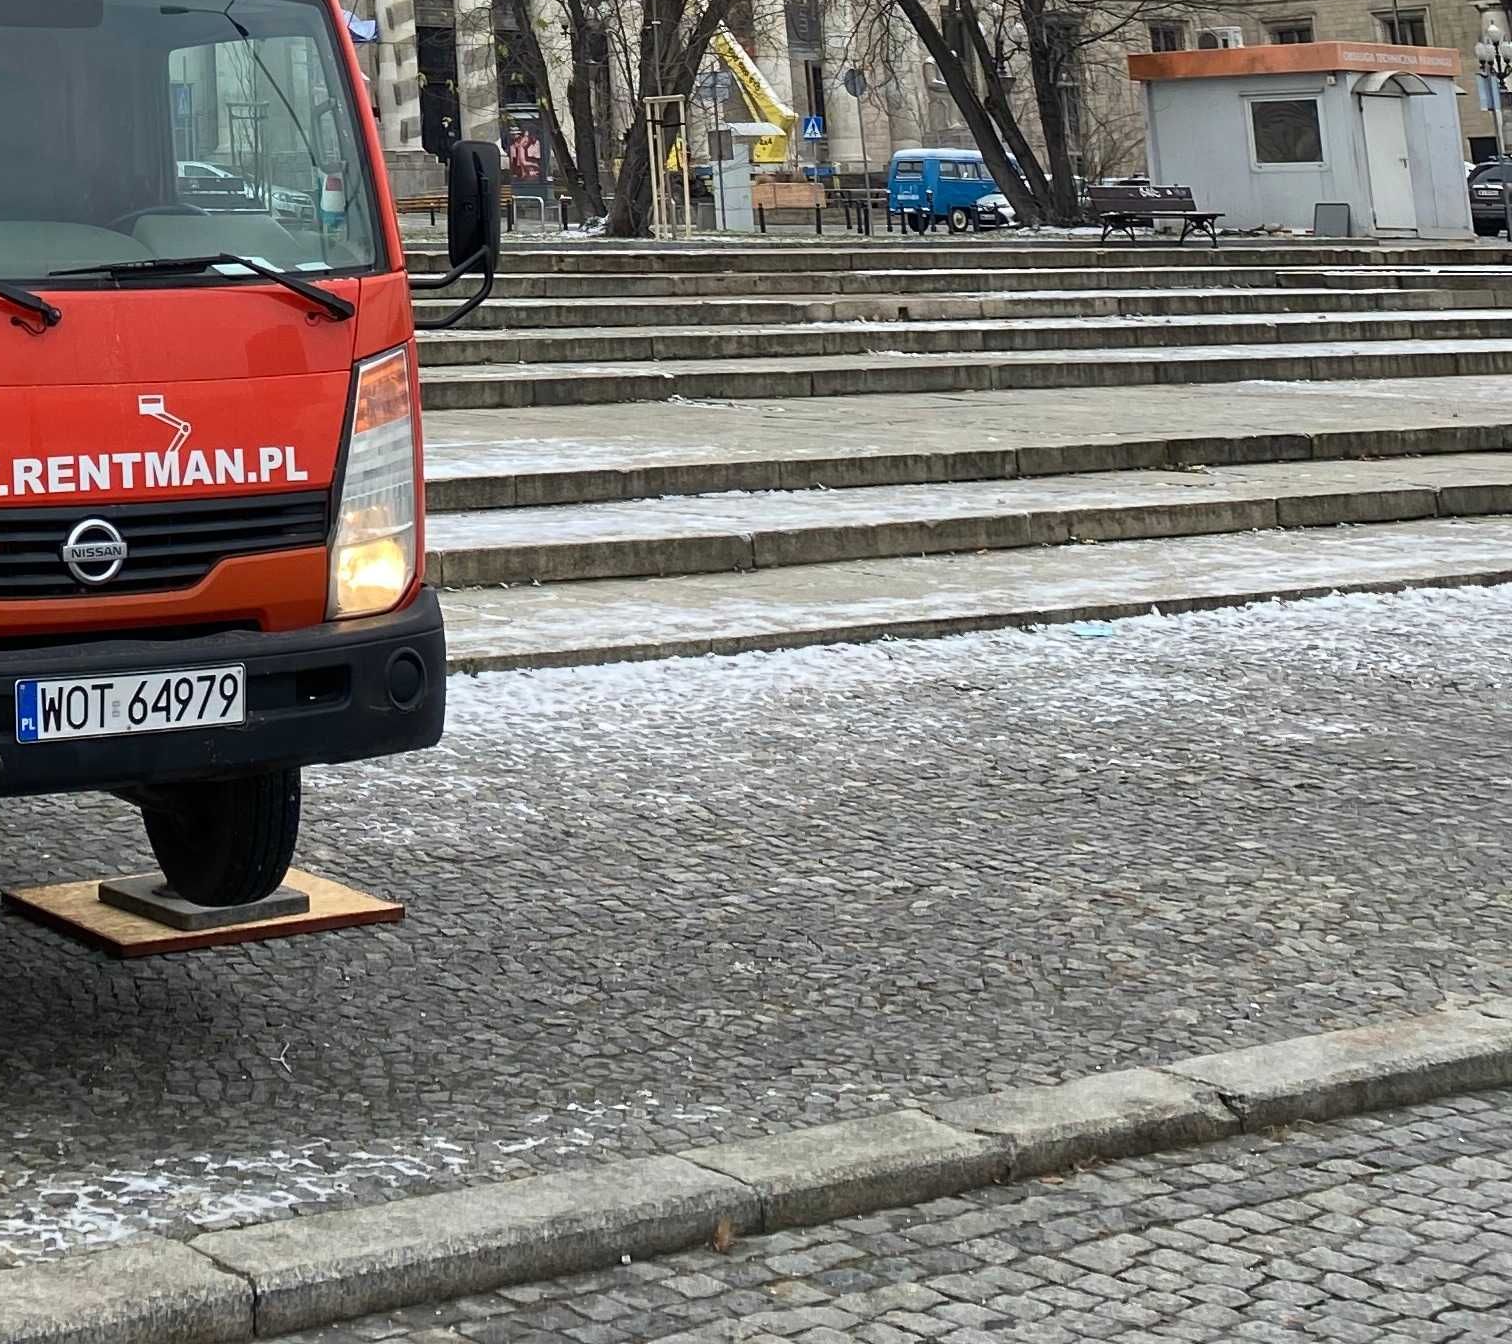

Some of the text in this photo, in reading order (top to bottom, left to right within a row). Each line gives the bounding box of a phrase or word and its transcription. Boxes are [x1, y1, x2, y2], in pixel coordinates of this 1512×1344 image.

[71, 546, 122, 558] NISSAN
[40, 672, 239, 733] WOT 64979
[21, 716, 36, 732] PL
